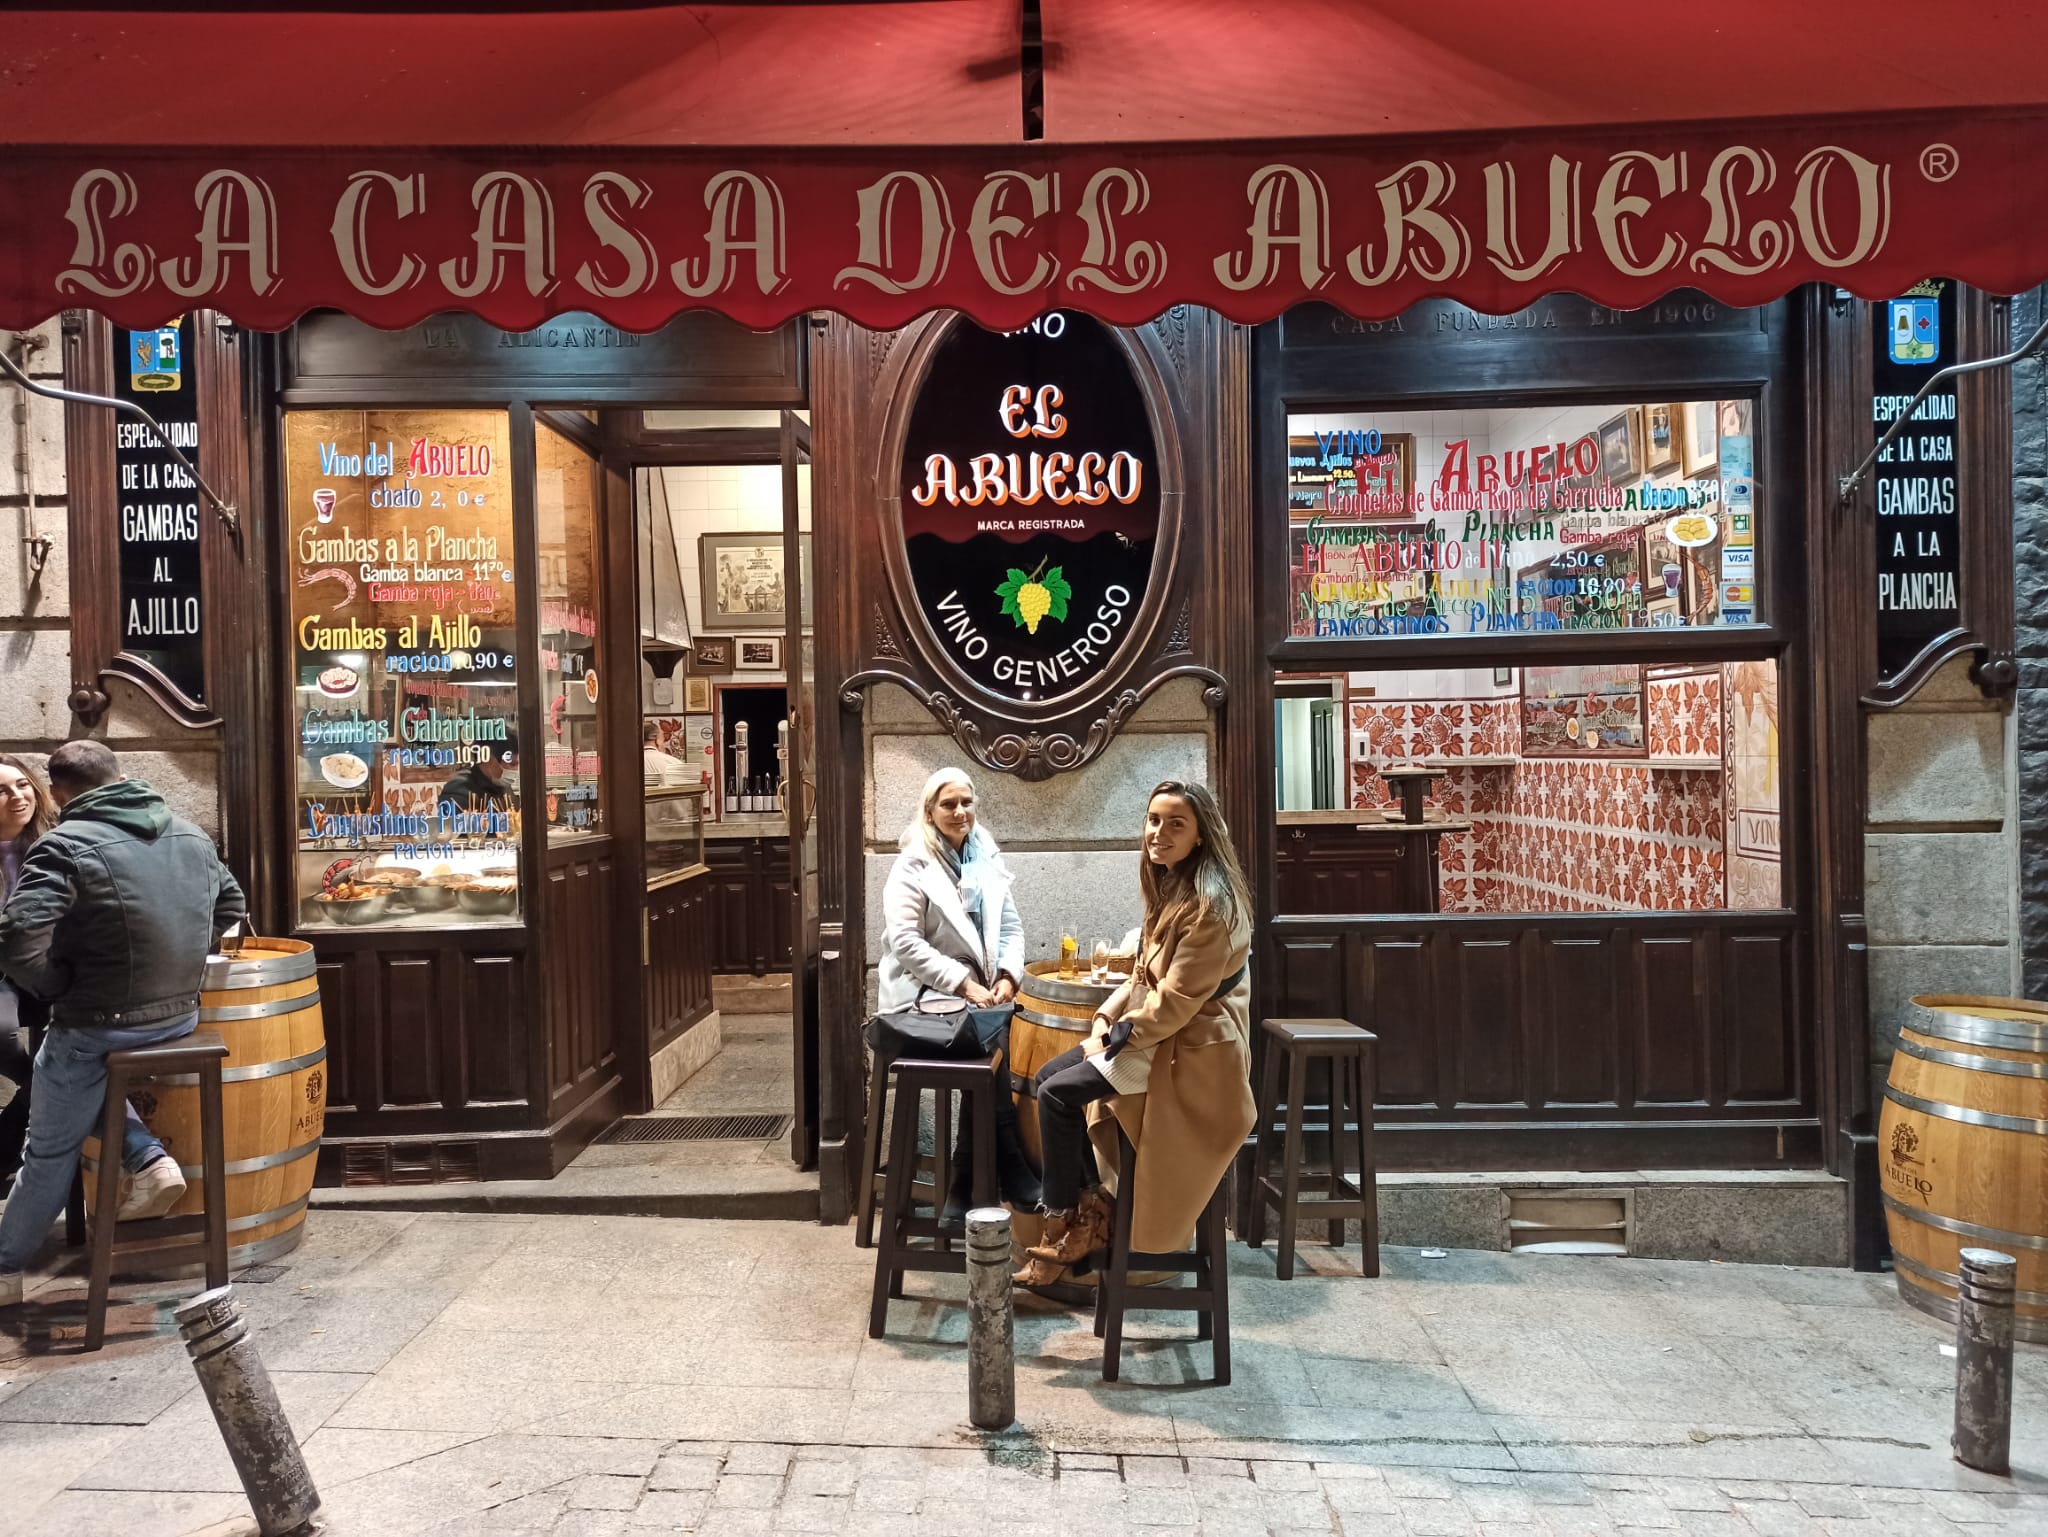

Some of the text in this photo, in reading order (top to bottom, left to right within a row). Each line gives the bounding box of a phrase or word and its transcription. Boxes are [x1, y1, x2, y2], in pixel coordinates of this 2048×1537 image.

[55, 169, 285, 298] LA
[329, 169, 793, 298] CASA
[833, 167, 1168, 296] DEL
[1213, 145, 1893, 291] ABUELO
[1434, 311, 1558, 332] FUNDADA
[1653, 303, 1716, 323] 1906
[998, 383, 1068, 439] EL
[318, 437, 493, 479] Vino del ABUELO
[1313, 428, 1382, 456] VINO
[1899, 436, 1914, 462] LA
[1920, 436, 1954, 462] CASA
[122, 464, 139, 490] DE
[144, 464, 159, 489] LA
[911, 450, 1143, 507] ABUELO
[1441, 437, 1599, 494] ABUELO
[369, 480, 422, 508] chato
[1324, 480, 1405, 520] Croquetas
[1408, 479, 1424, 513] de
[1430, 478, 1484, 512] Gamba
[1489, 477, 1524, 516] Roja
[1527, 476, 1549, 512] de
[1550, 473, 1625, 510] Garrucha
[1877, 477, 1955, 516] GAMBAS
[122, 504, 199, 542] GAMBAS
[977, 519, 1086, 531] MARCA REGISTRADA
[1307, 515, 1390, 546] GAMBAS
[1461, 508, 1555, 543] PLANCHA
[1560, 528, 1604, 544] Gamba
[299, 525, 498, 564] Gambas a la Plancha
[1300, 542, 1332, 575] EL
[1349, 540, 1463, 575] ABUELO
[1550, 551, 1589, 569] 2,50
[1728, 554, 1751, 562] VISA
[1893, 531, 1941, 557] A LA
[153, 556, 173, 583] AL
[360, 563, 409, 583] Gamba
[414, 562, 463, 582] blanca
[368, 582, 419, 602] Gamba
[423, 582, 453, 609] roja
[1383, 592, 1408, 617] de
[1423, 587, 1476, 616] Arce
[1588, 584, 1620, 612] 50
[1878, 572, 1957, 611] PLANCHA
[127, 597, 199, 636] AJILLO
[299, 614, 482, 654] Gambas al Ajillo
[1316, 615, 1450, 637] LANGOSTINOS
[1469, 602, 1561, 633] PLANCHA
[1725, 614, 1749, 624] VISA
[936, 584, 1131, 687] VINO GENEROSO
[303, 706, 508, 744] Gambas Gabardina
[308, 800, 510, 845] Langostinos Plancha
[1884, 1161, 1933, 1195] ABUELO
